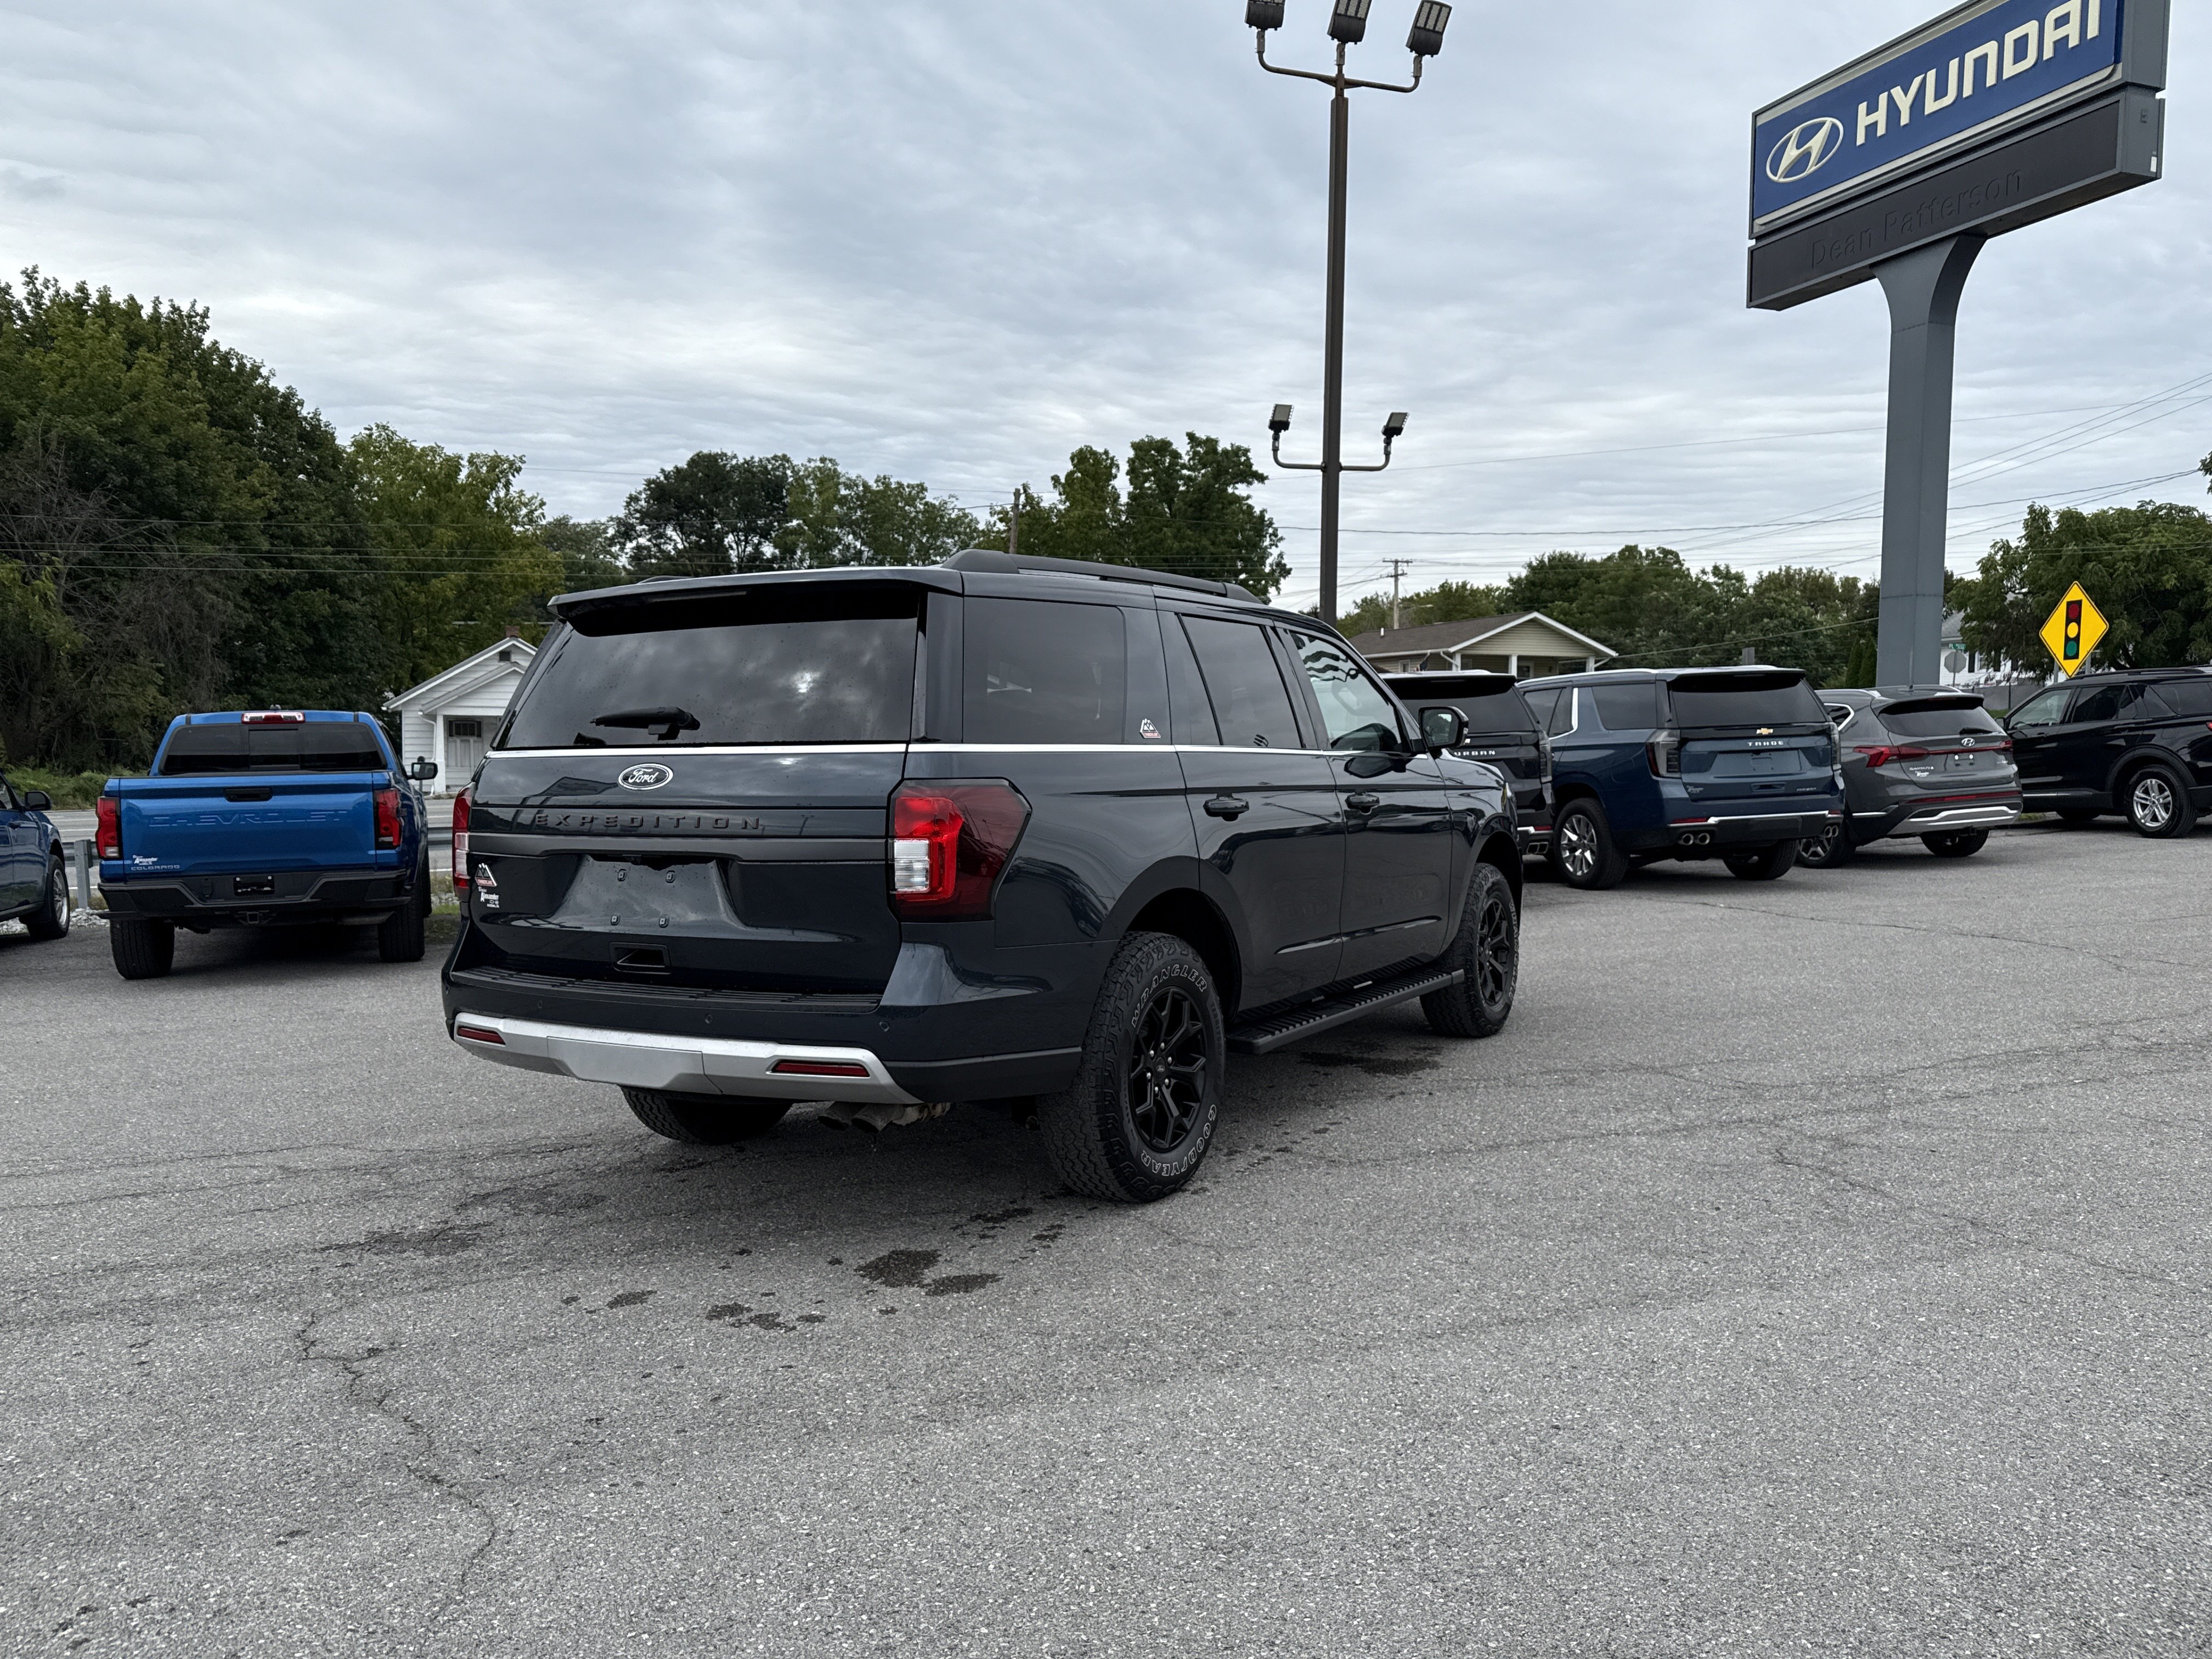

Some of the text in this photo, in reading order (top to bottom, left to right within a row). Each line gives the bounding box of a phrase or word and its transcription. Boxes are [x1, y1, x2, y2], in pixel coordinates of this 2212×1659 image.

[1857, 0, 2100, 146] HYUNDAI
[1812, 170, 2021, 269] Dean Patterson
[628, 768, 659, 783] Ford
[149, 811, 347, 827] CHEVROLET
[535, 814, 759, 830] EXPEDITION
[1131, 964, 1207, 1028] WRANGLER
[1141, 1104, 1217, 1176] GOODYEAR
